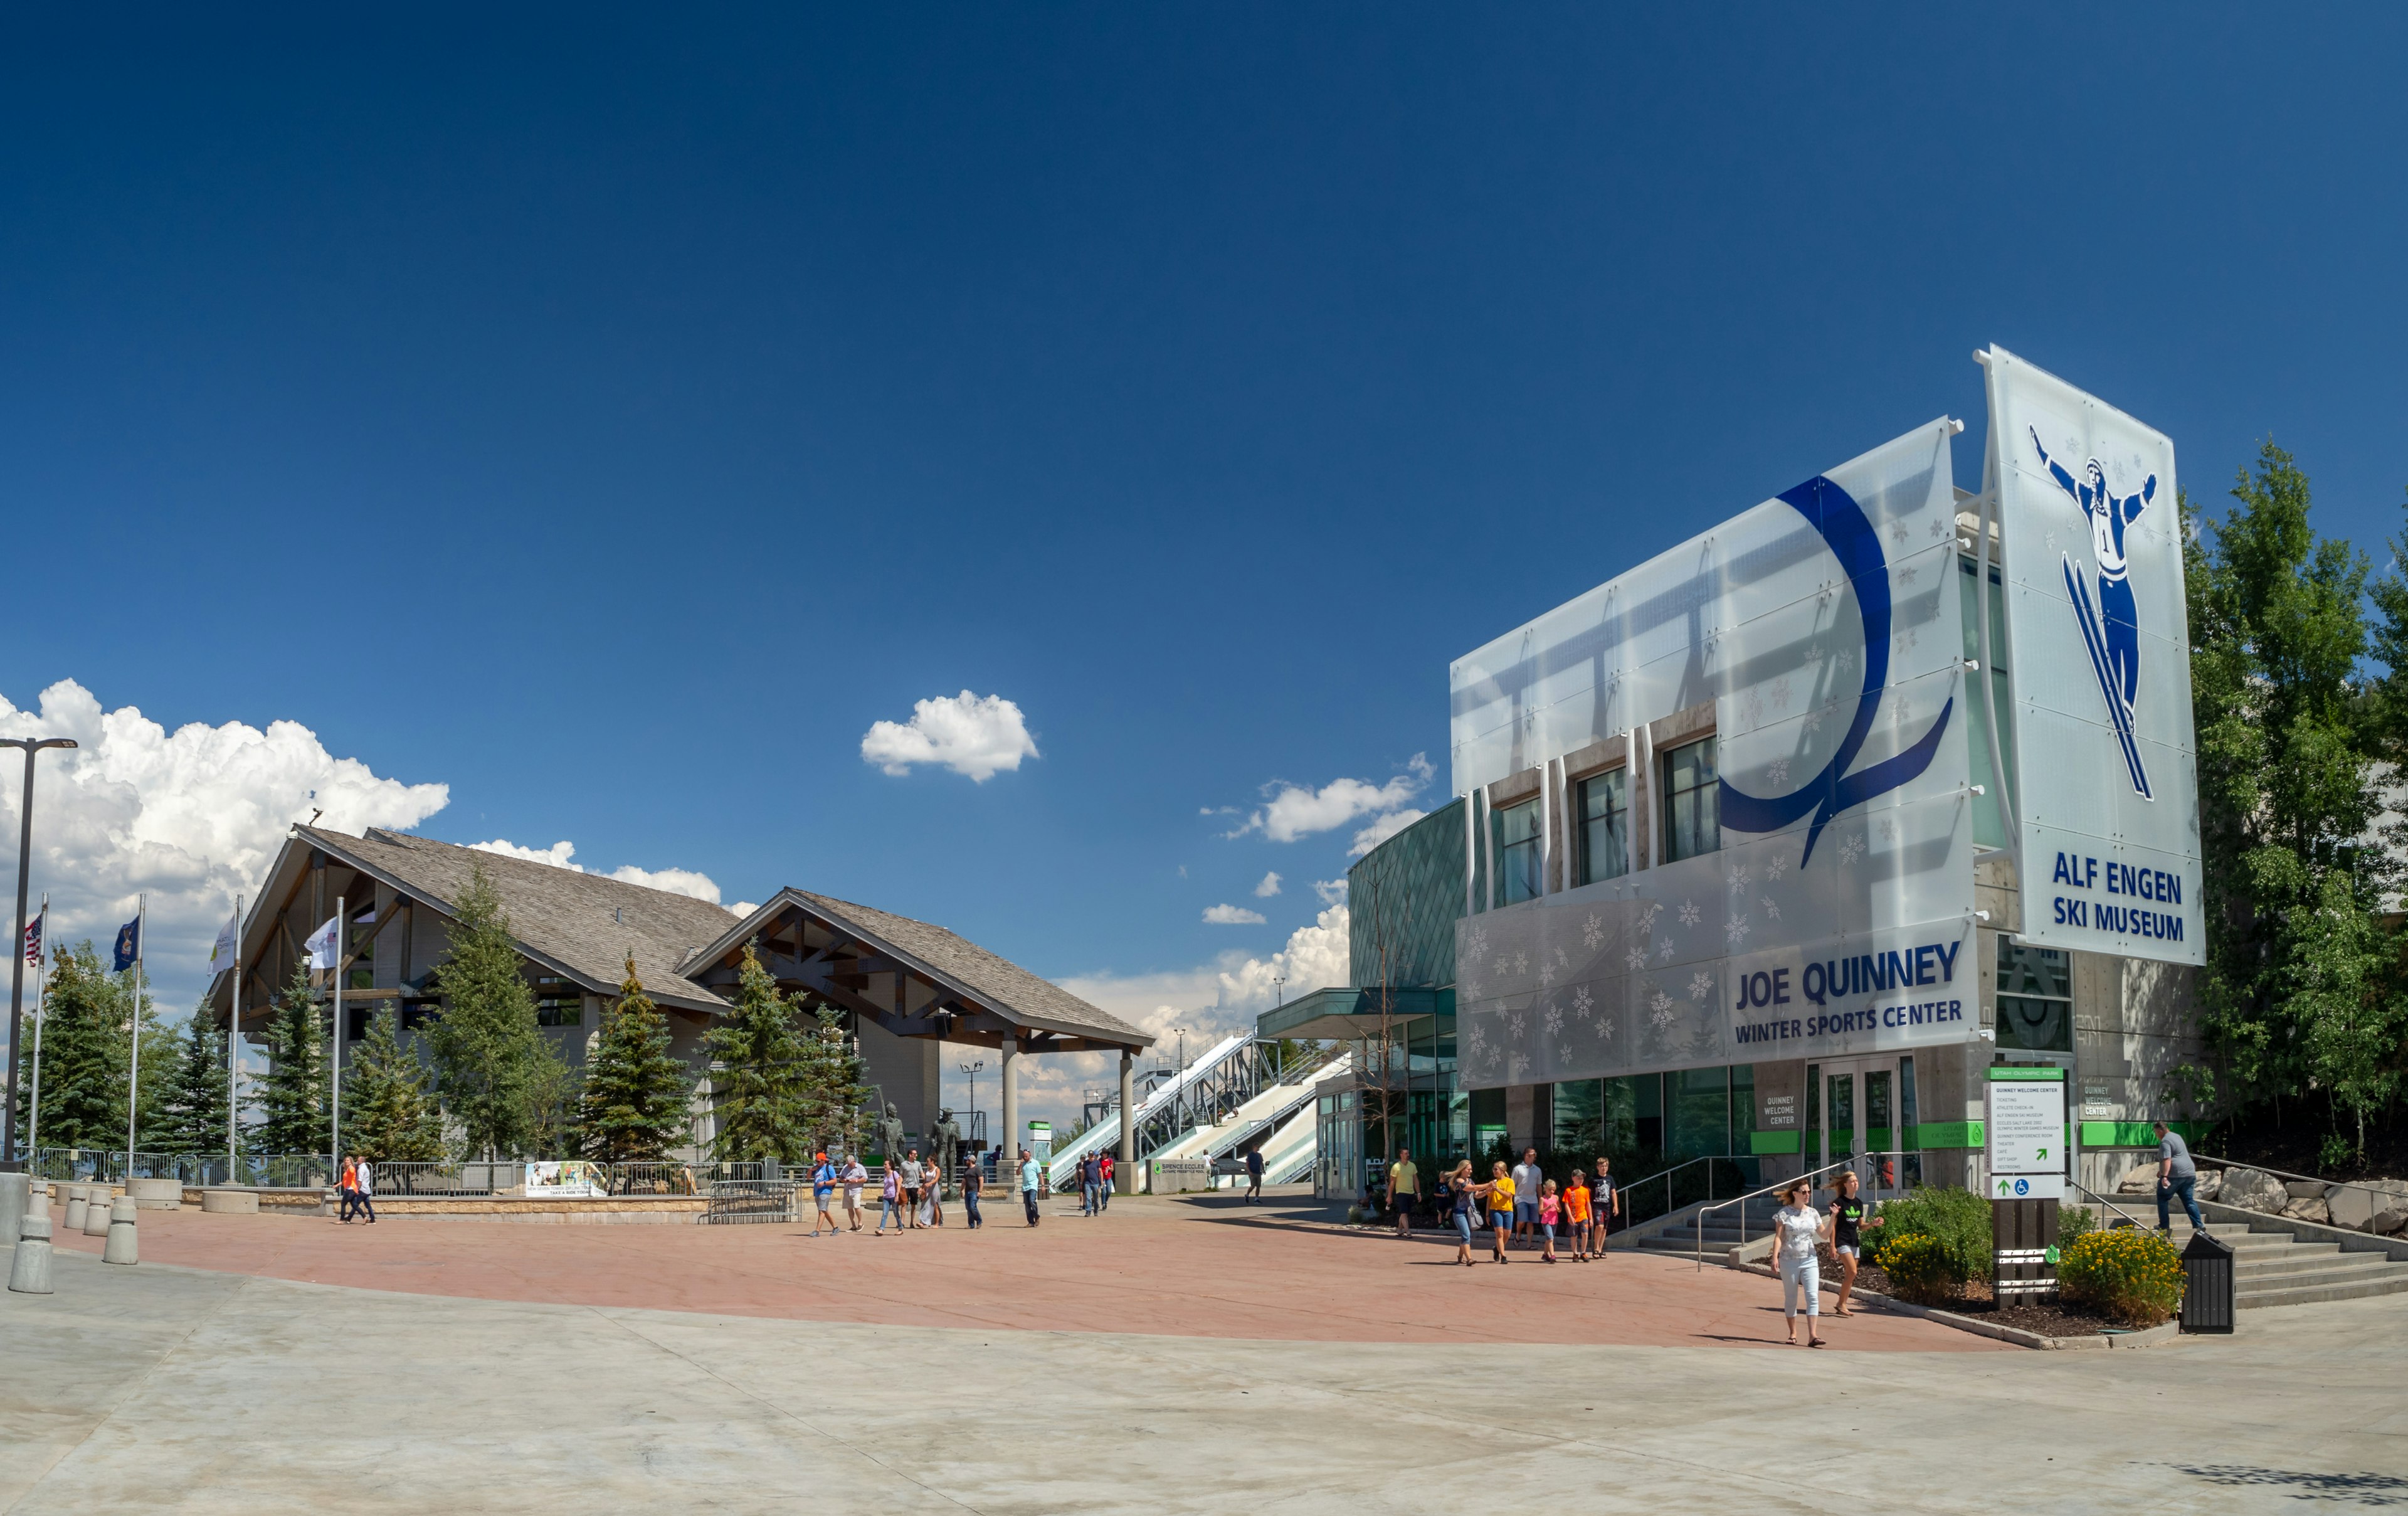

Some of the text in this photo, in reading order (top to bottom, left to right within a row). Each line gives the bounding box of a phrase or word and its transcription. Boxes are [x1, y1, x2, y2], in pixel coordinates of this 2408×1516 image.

[2052, 851, 2182, 904] ALF ENGEN
[2054, 896, 2184, 941] SKI MUSEUM
[1736, 940, 1961, 1010] JOE QUINNEY
[1736, 1000, 1962, 1044] WINTER SPORTS CENTER
[2084, 1086, 2109, 1095] QUINNEY
[1768, 1096, 1794, 1105] QUINNEY
[2085, 1097, 2111, 1106] WELCOME
[1765, 1106, 1794, 1115] WELCOME
[2085, 1107, 2107, 1115] CENTER
[1771, 1116, 1794, 1125] CENTER
